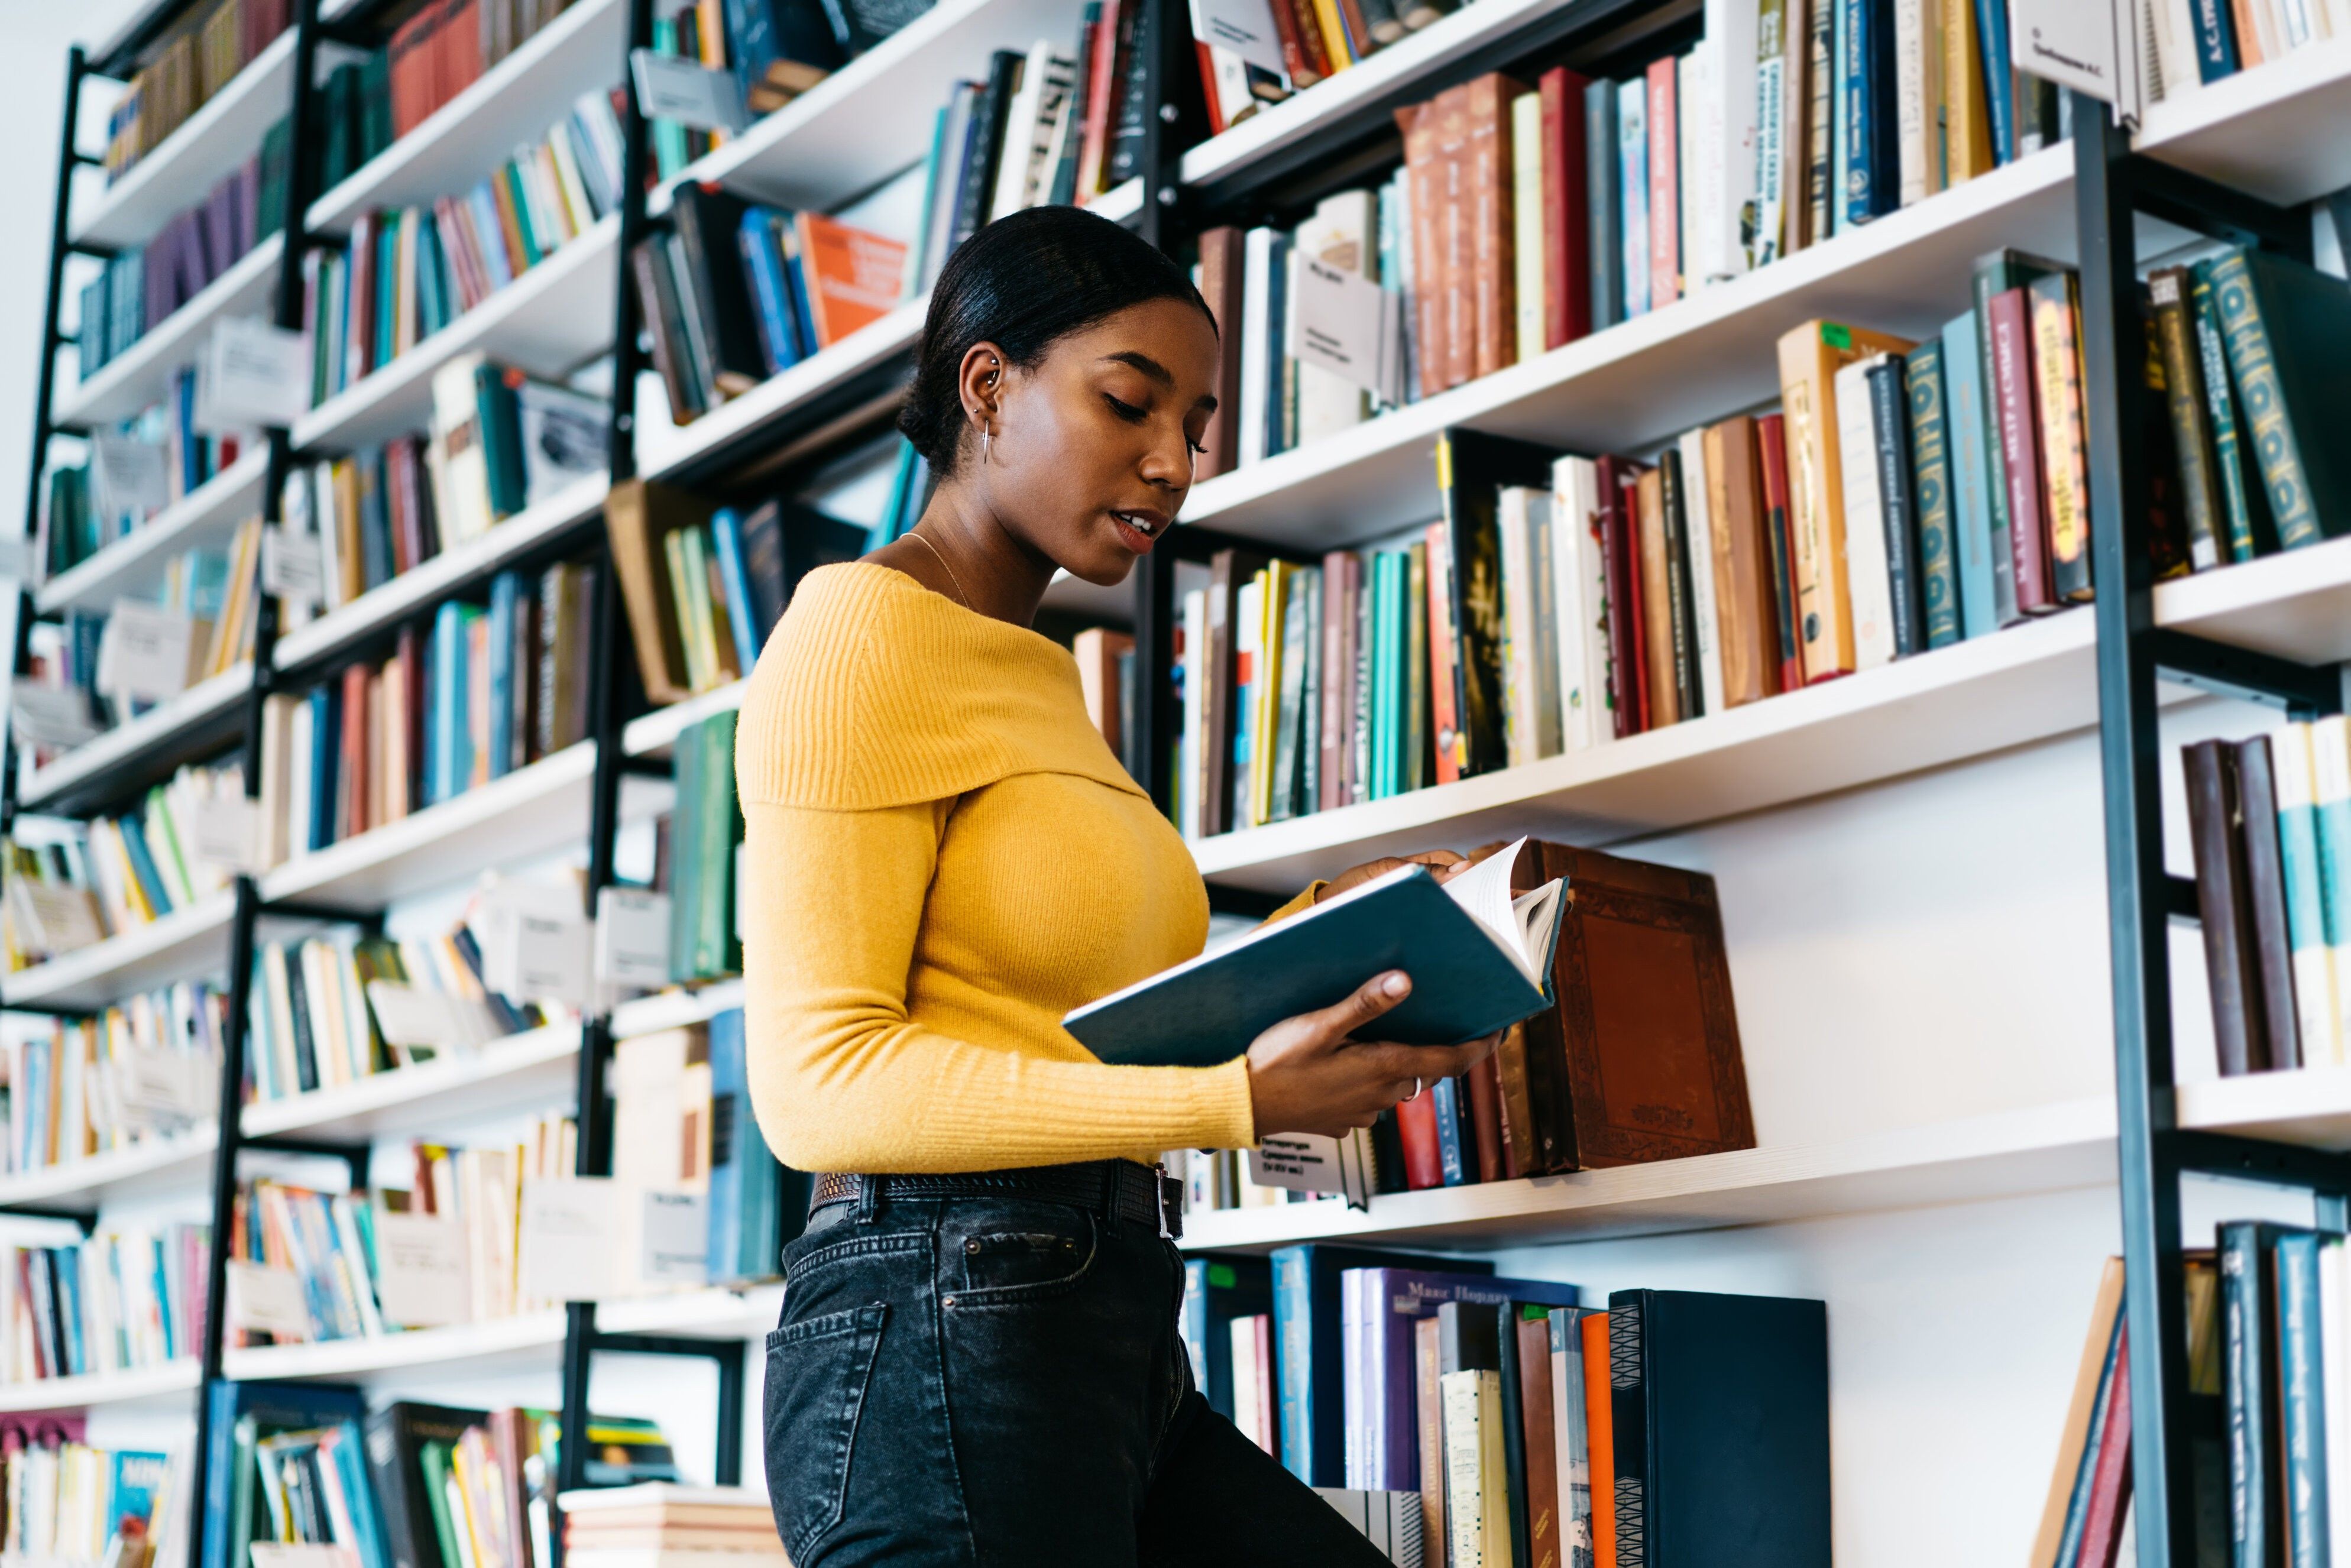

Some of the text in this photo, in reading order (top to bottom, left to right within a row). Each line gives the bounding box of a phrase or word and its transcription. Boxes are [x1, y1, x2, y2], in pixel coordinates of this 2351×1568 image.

[1996, 322, 2014, 394] СМЫСЛ
[2005, 412, 2019, 461] МЕТР
[1408, 1281, 1449, 1298] Макс
